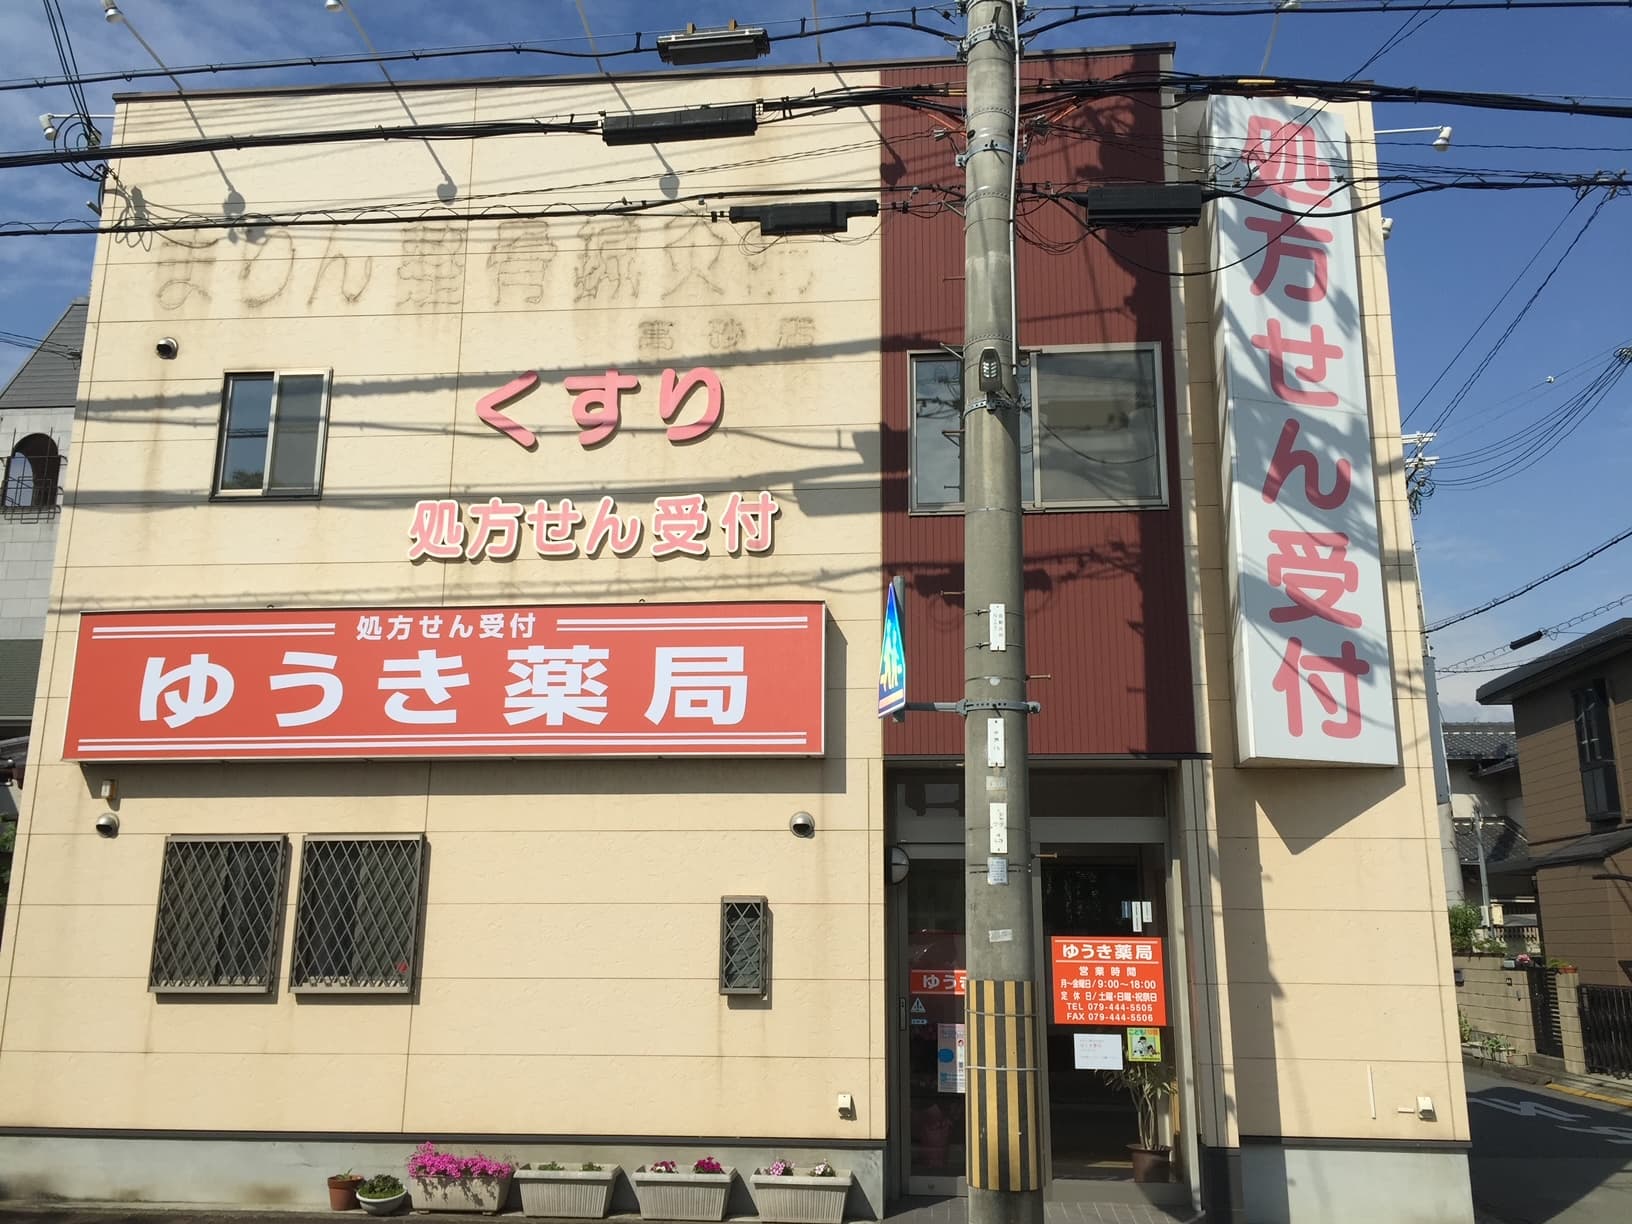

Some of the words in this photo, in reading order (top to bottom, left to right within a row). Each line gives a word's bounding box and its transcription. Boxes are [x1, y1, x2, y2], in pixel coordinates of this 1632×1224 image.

[475, 366, 724, 448] くすり
[1241, 115, 1370, 739] 処方せん受付
[409, 491, 780, 561] 処方せん受付
[356, 613, 536, 641] 処方せん受付
[138, 644, 749, 729] ゆうき薬局
[1062, 943, 1153, 961] ゆうき薬局
[1079, 966, 1137, 977] 営業時間
[1066, 1002, 1084, 1011] TEL
[1066, 1012, 1085, 1021] FAX
